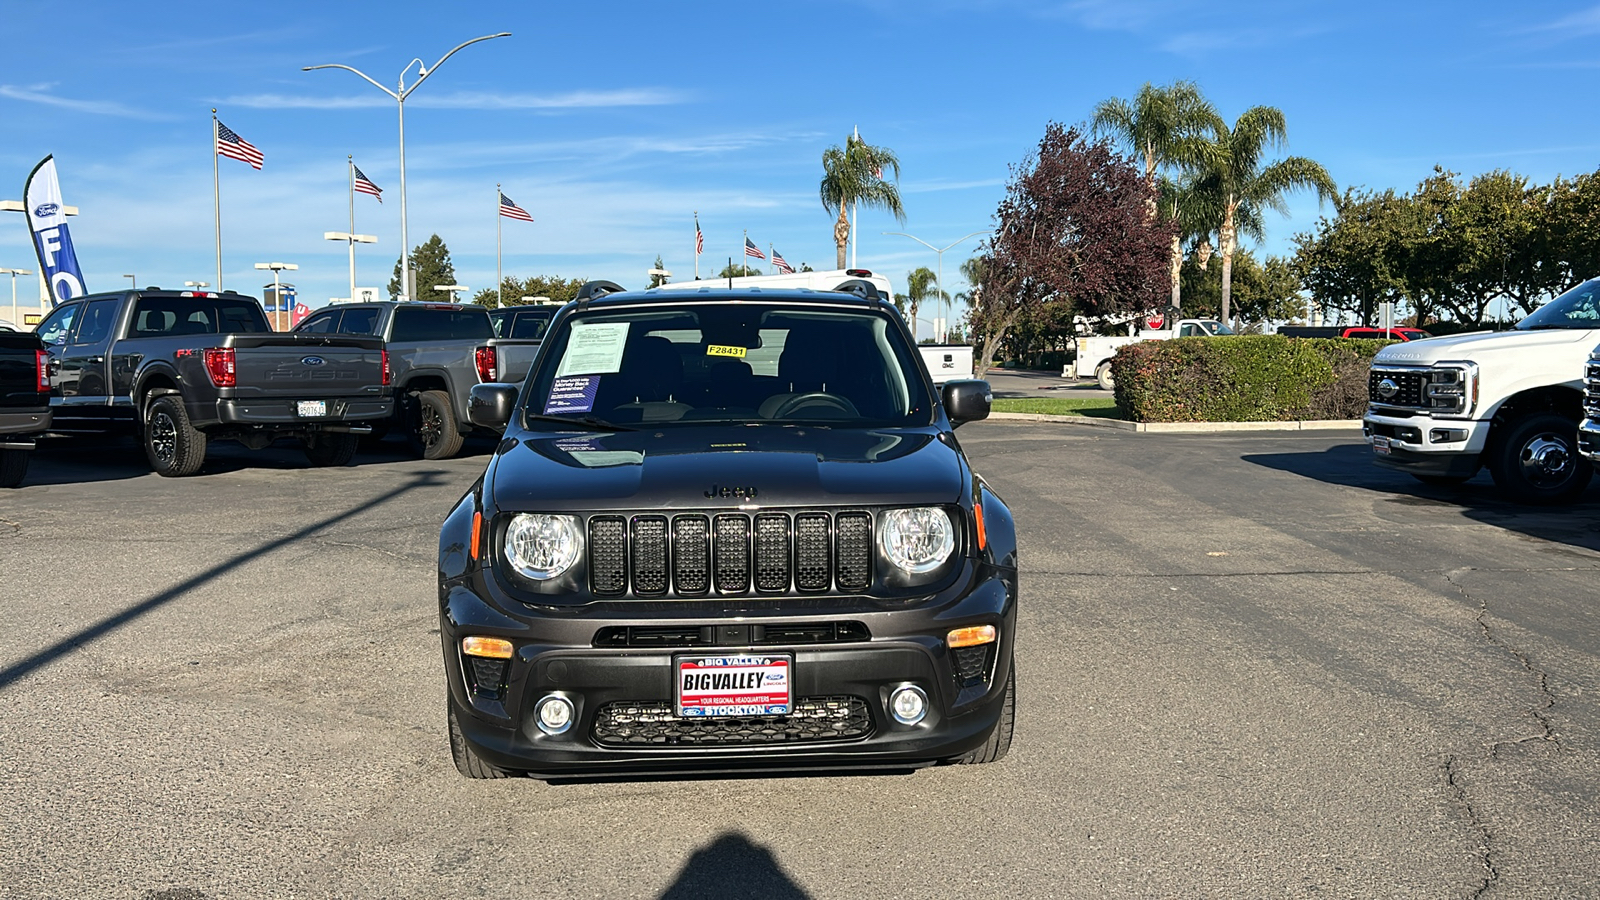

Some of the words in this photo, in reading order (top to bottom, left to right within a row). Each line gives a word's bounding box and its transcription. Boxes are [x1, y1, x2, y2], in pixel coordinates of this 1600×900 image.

[36, 204, 59, 217] Ford
[177, 348, 199, 358] FX4
[709, 346, 744, 356] F28431
[703, 484, 758, 502] Jeep
[704, 658, 724, 666] BIG
[726, 658, 764, 666] VALLEY
[704, 706, 765, 716] STOCKTON
